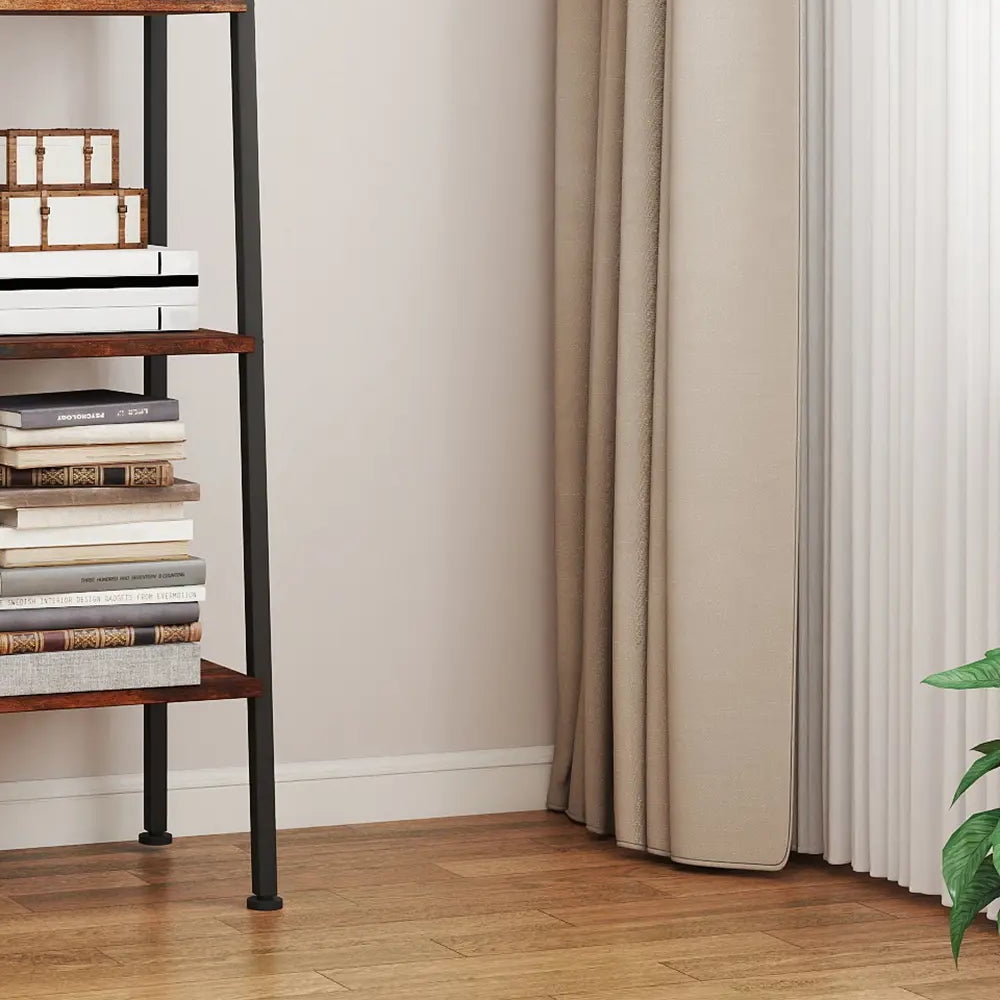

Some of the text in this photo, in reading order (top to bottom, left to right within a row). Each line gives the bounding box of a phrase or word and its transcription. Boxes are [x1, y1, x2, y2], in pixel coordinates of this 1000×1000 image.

[57, 412, 105, 421] PSYCHOLOGY
[7, 599, 36, 607] SWEDISH
[40, 597, 73, 605] INTERIOR
[76, 595, 101, 603] DESIGN
[137, 593, 153, 601] FROM
